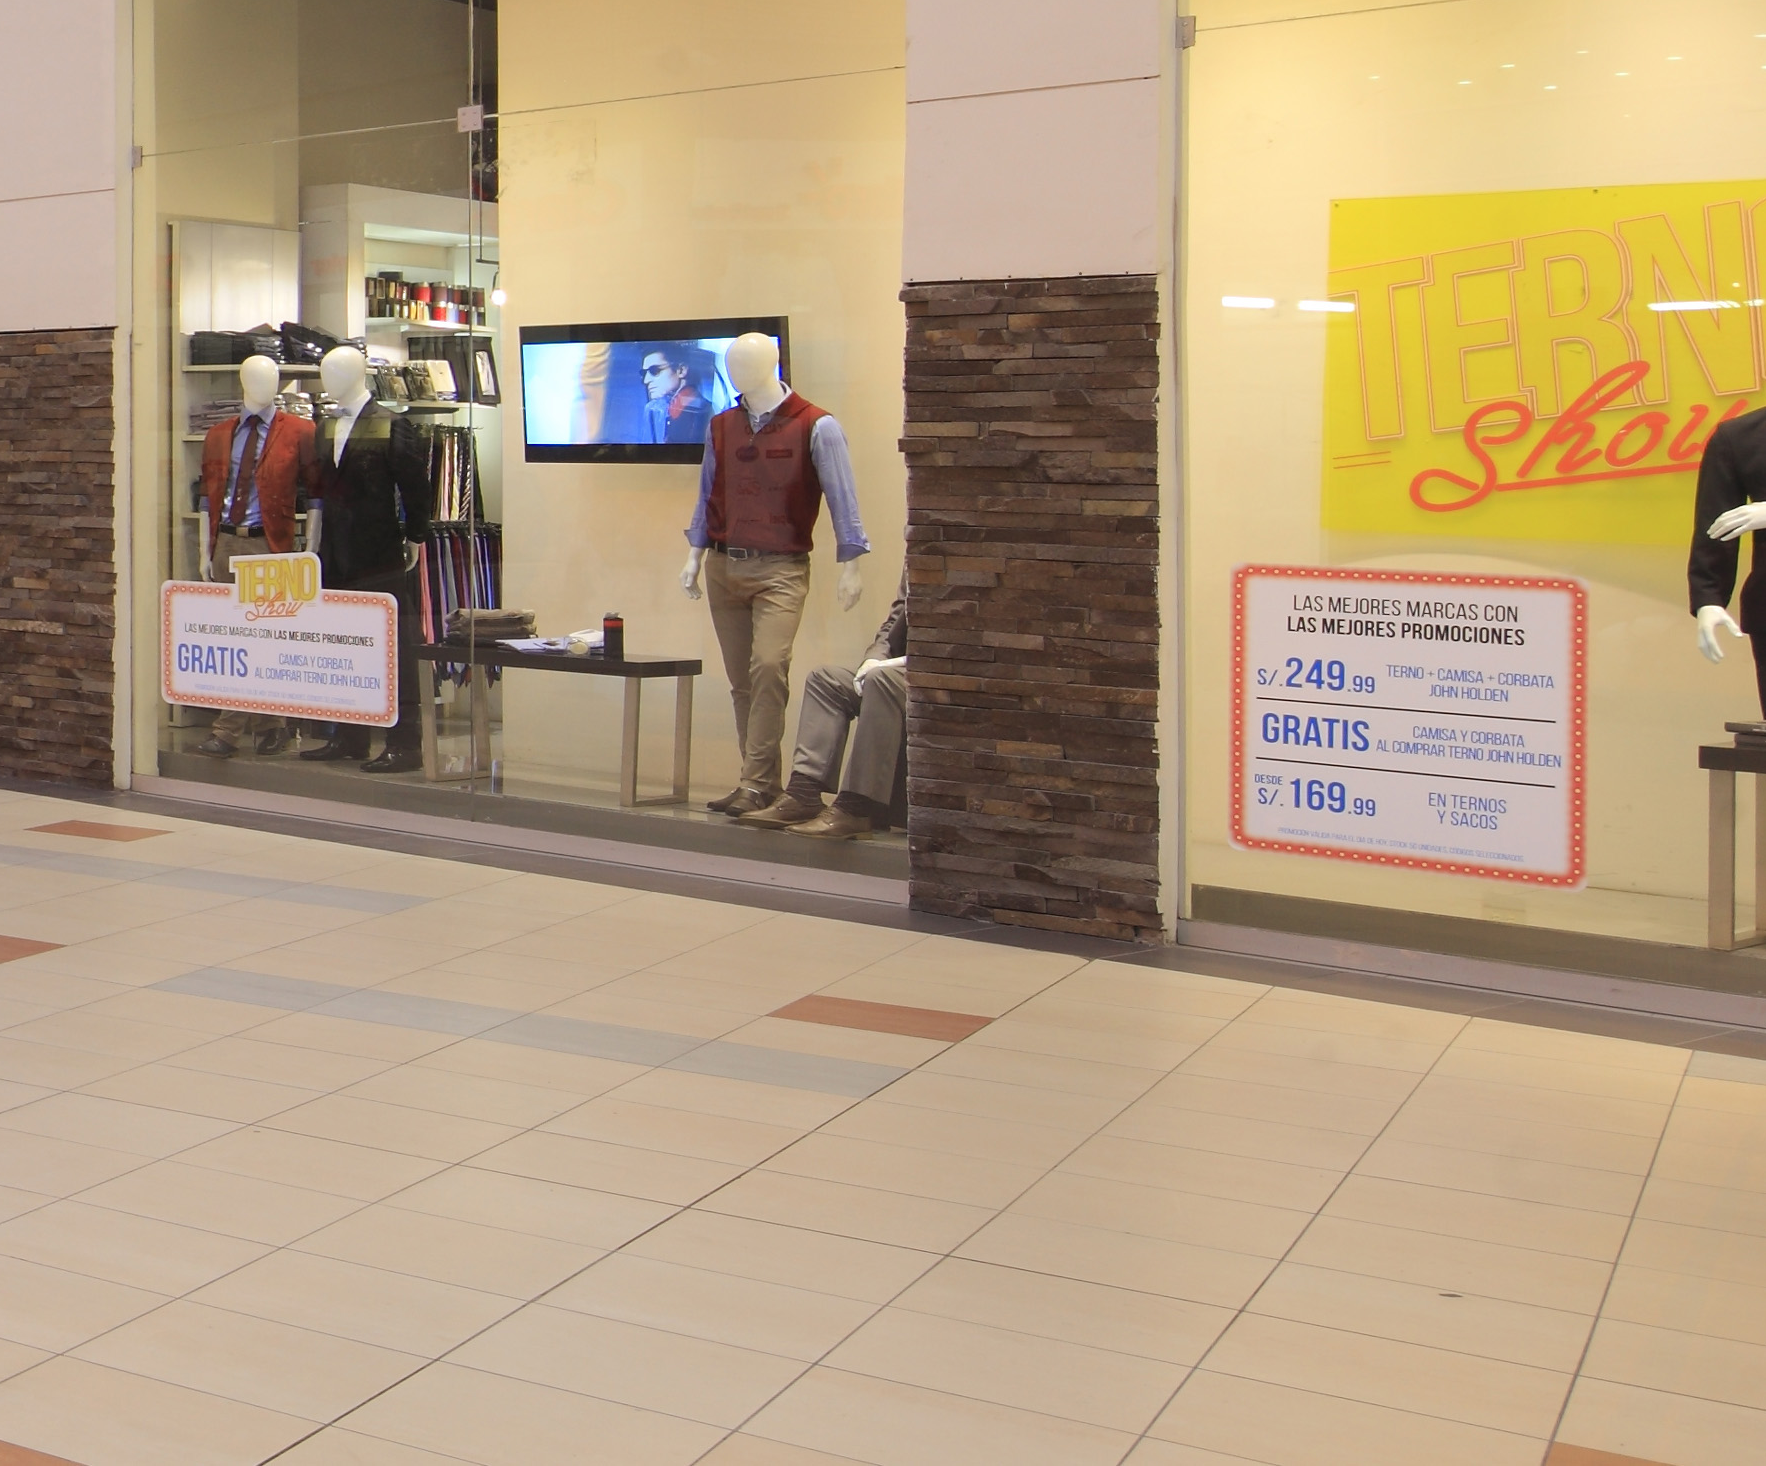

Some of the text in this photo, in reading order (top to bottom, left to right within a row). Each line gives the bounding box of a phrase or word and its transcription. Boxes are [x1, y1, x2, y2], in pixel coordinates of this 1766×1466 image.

[1326, 197, 1766, 441] TERN
[234, 557, 316, 603] TERNO
[245, 591, 304, 621] Show
[1293, 594, 1519, 623] LAS MEJORES MARCAS CON
[184, 622, 374, 647] LAS MEJORES MARCAS CON LAS MEJORES PROMOCIONES
[1287, 616, 1525, 646] LAS MEJORES PROMOCIONES
[178, 643, 249, 678] GRATIS
[278, 653, 353, 671] CAMISA Y CORBATA
[254, 669, 380, 690] AL COMPRAR TERNO JOHN HOLDEN
[1386, 664, 1424, 680] TERNO
[1437, 668, 1484, 684] CAMISA
[1497, 672, 1555, 689] CORBATA
[1428, 684, 1509, 703] JOHN HOLDEN
[1261, 712, 1370, 752] GRATIS
[1412, 726, 1525, 748] CAMISA Y CORBATA
[1376, 739, 1562, 768] AL COMPRAR TERNO JOHN HOLDEN
[1254, 773, 1283, 786] DESDE
[1428, 792, 1507, 814] EN TERNOS
[1437, 809, 1498, 830] Y SACOS
